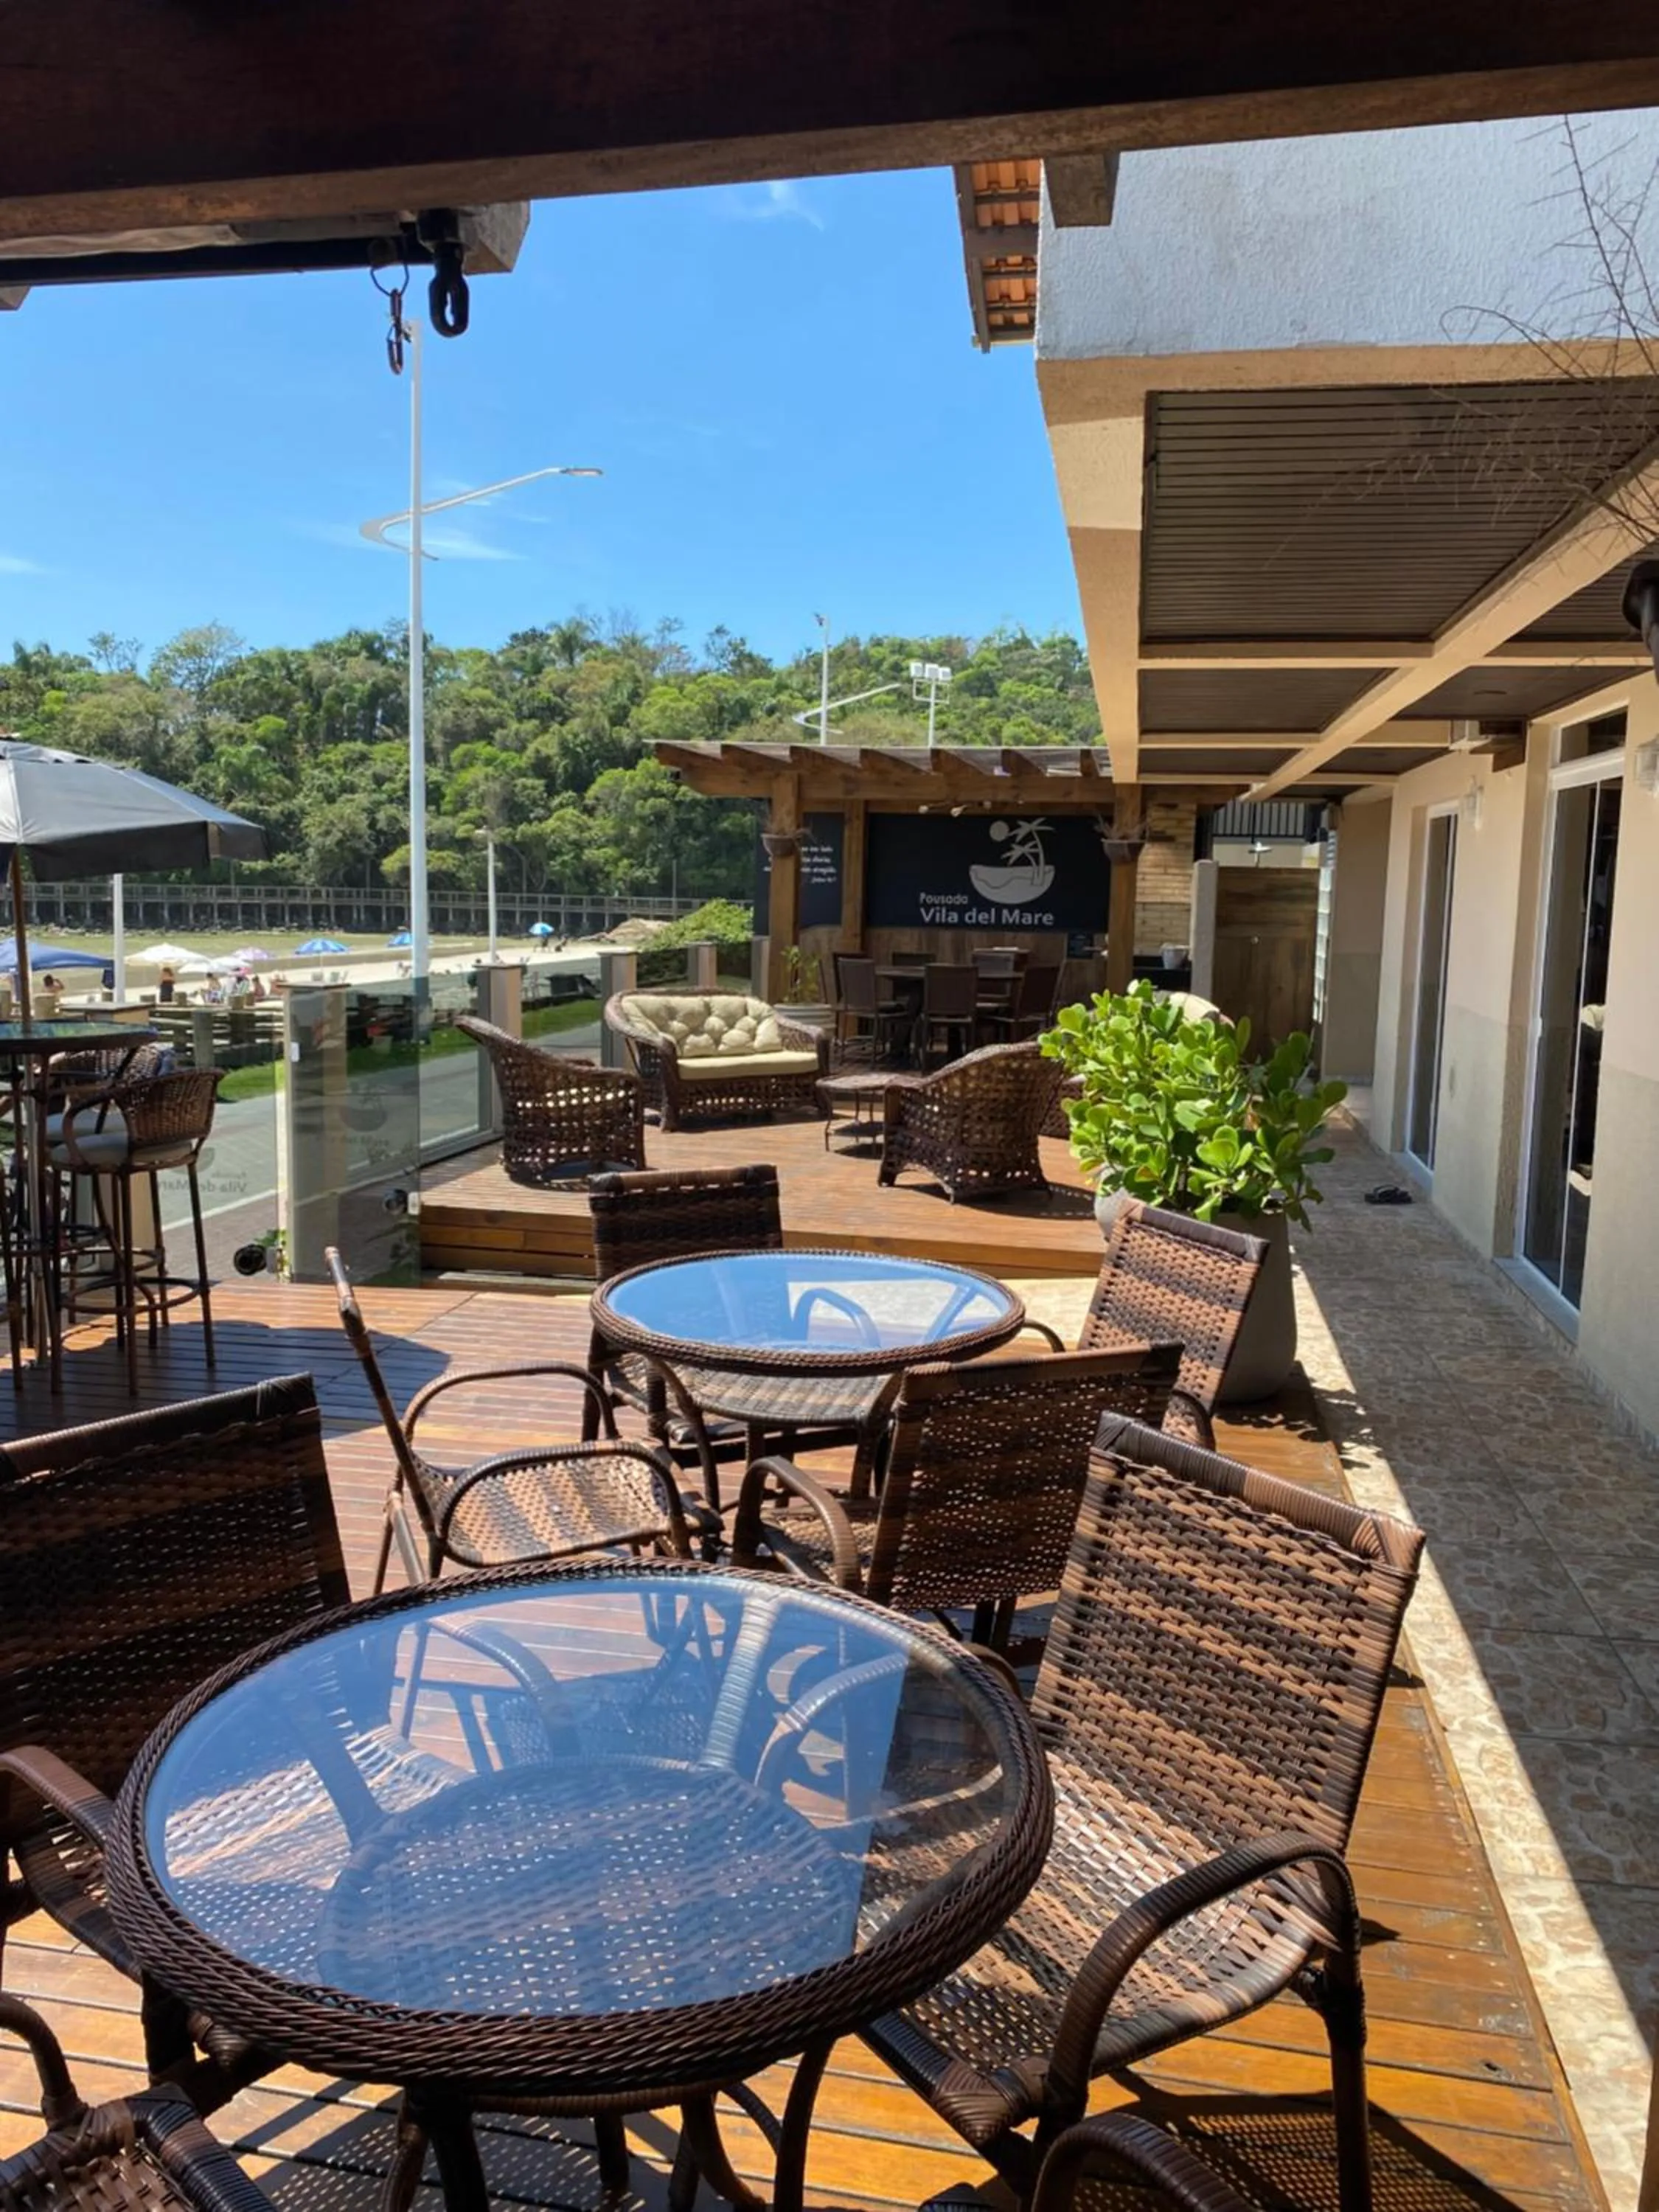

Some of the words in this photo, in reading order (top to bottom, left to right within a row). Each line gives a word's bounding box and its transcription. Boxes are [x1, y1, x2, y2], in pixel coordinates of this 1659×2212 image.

[919, 892, 969, 905] Pousada
[920, 907, 959, 923] Vila
[964, 908, 995, 924] del
[1001, 908, 1055, 925] Mare
